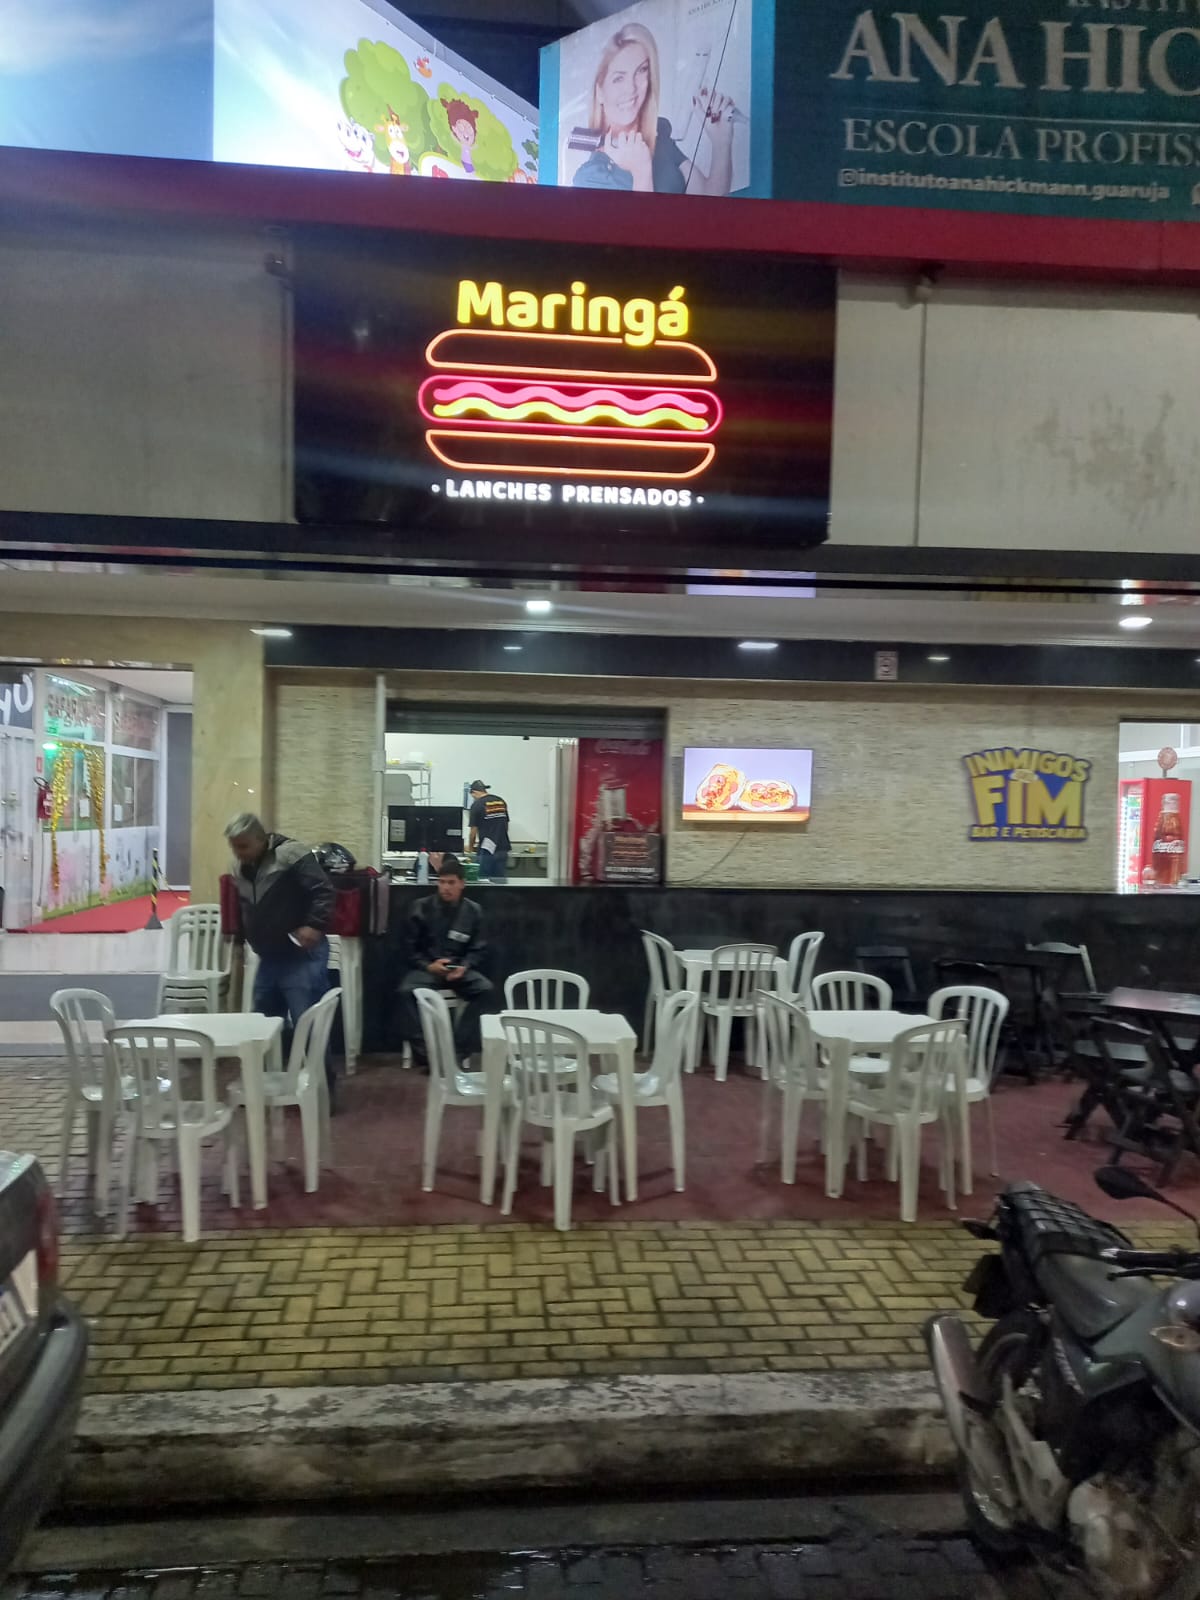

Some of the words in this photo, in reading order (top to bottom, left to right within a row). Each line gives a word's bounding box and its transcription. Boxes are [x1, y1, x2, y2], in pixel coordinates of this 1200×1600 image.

[829, 9, 1026, 88] ANA
[1040, 21, 1200, 96] HIC
[843, 118, 1023, 160] ESCOLA
[457, 279, 689, 346] Maringá
[445, 479, 552, 502] LANCHES
[562, 484, 692, 507] PRENSADOS
[964, 749, 1091, 782] INIMIGOS
[972, 774, 1082, 826] FIM
